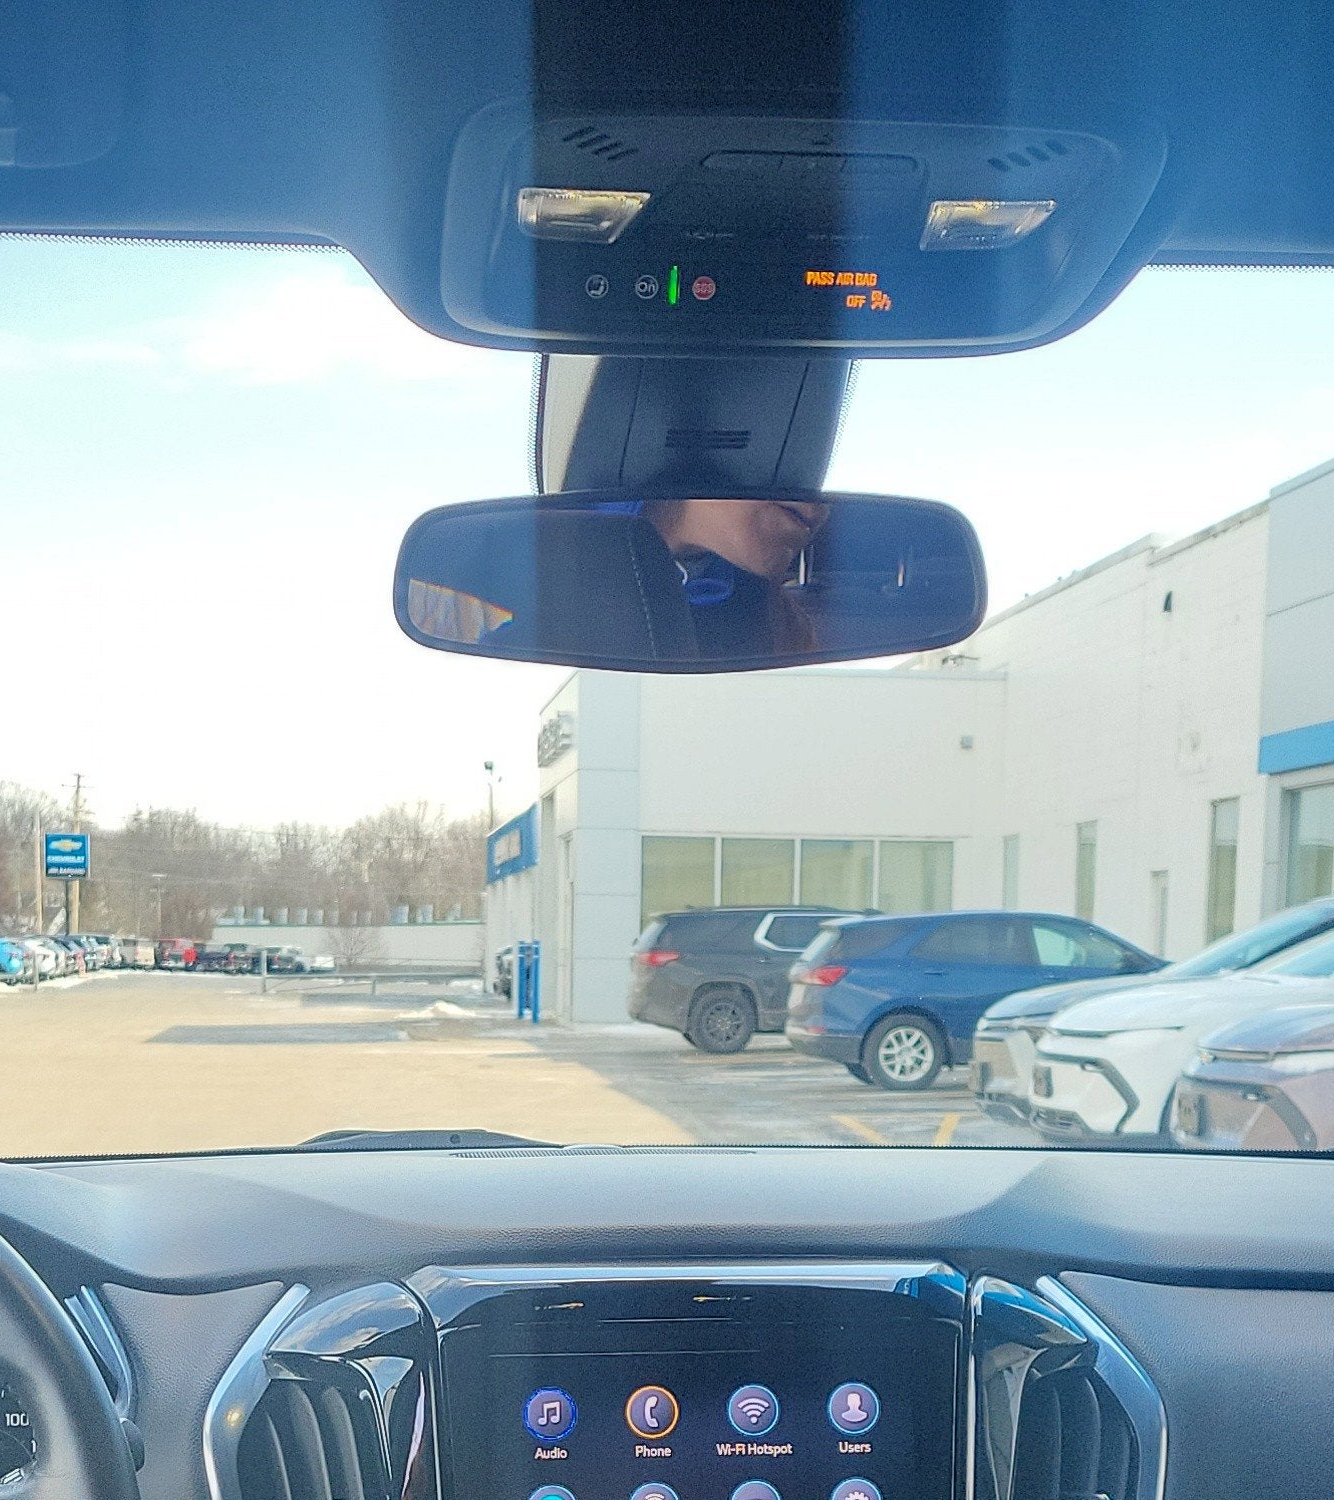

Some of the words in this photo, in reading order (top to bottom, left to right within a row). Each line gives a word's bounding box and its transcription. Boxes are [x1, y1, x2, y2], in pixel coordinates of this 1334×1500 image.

[806, 271, 835, 285] PASS
[836, 272, 854, 286] AIR
[846, 294, 867, 309] OFF
[5, 1413, 30, 1427] 100
[534, 1447, 568, 1460] Audio
[635, 1445, 672, 1458] Phone
[716, 1443, 746, 1456] Wi-Fi
[748, 1443, 793, 1458] Hotspot
[839, 1441, 872, 1454] Users
